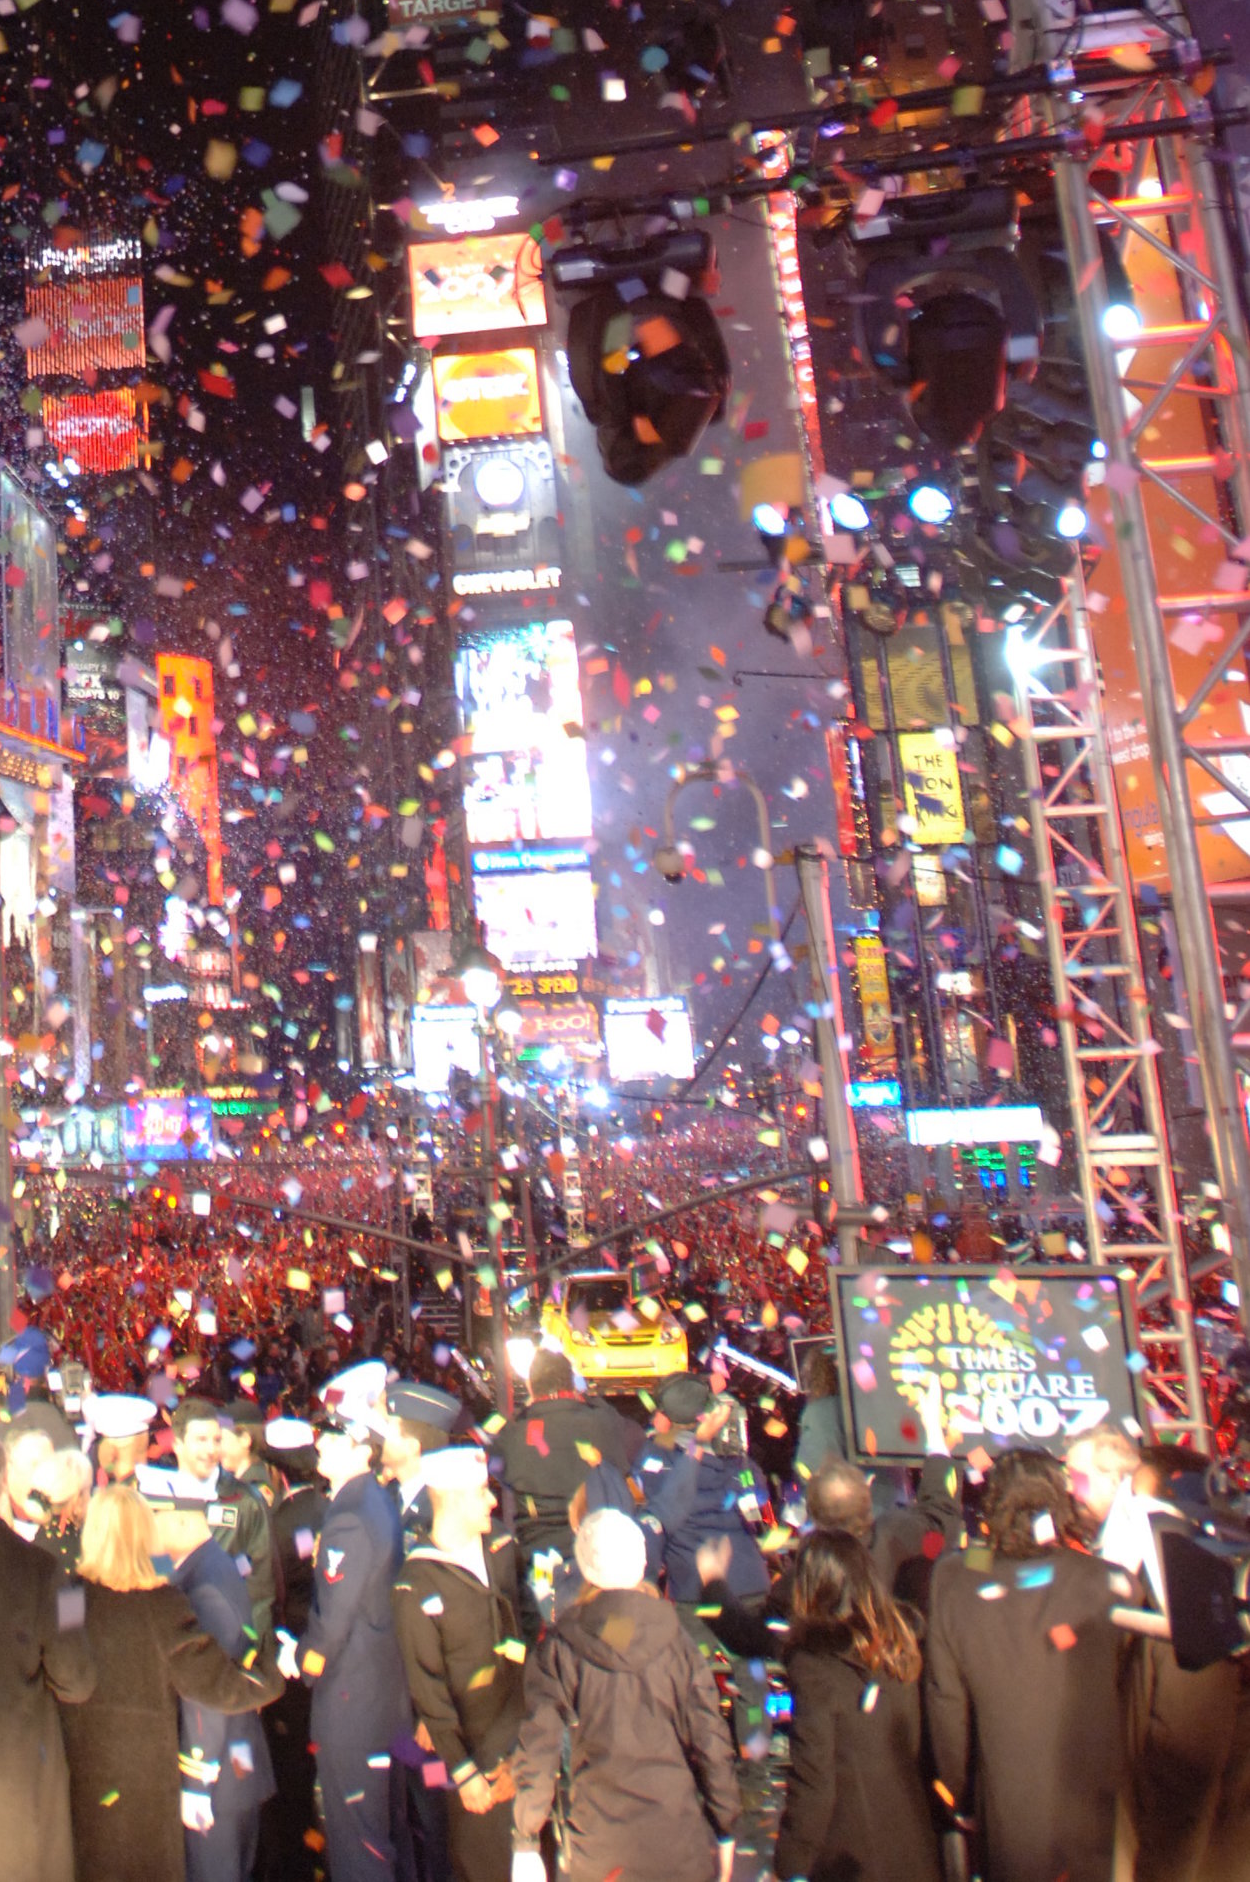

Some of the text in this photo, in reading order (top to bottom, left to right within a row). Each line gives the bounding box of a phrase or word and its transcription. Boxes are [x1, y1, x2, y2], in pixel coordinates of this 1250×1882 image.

[453, 567, 562, 595] CHEVROLET
[913, 753, 944, 768] THE
[948, 1345, 1037, 1372] TIMES
[965, 1372, 1098, 1400] SQUARE
[945, 1392, 1110, 1440] 2007
